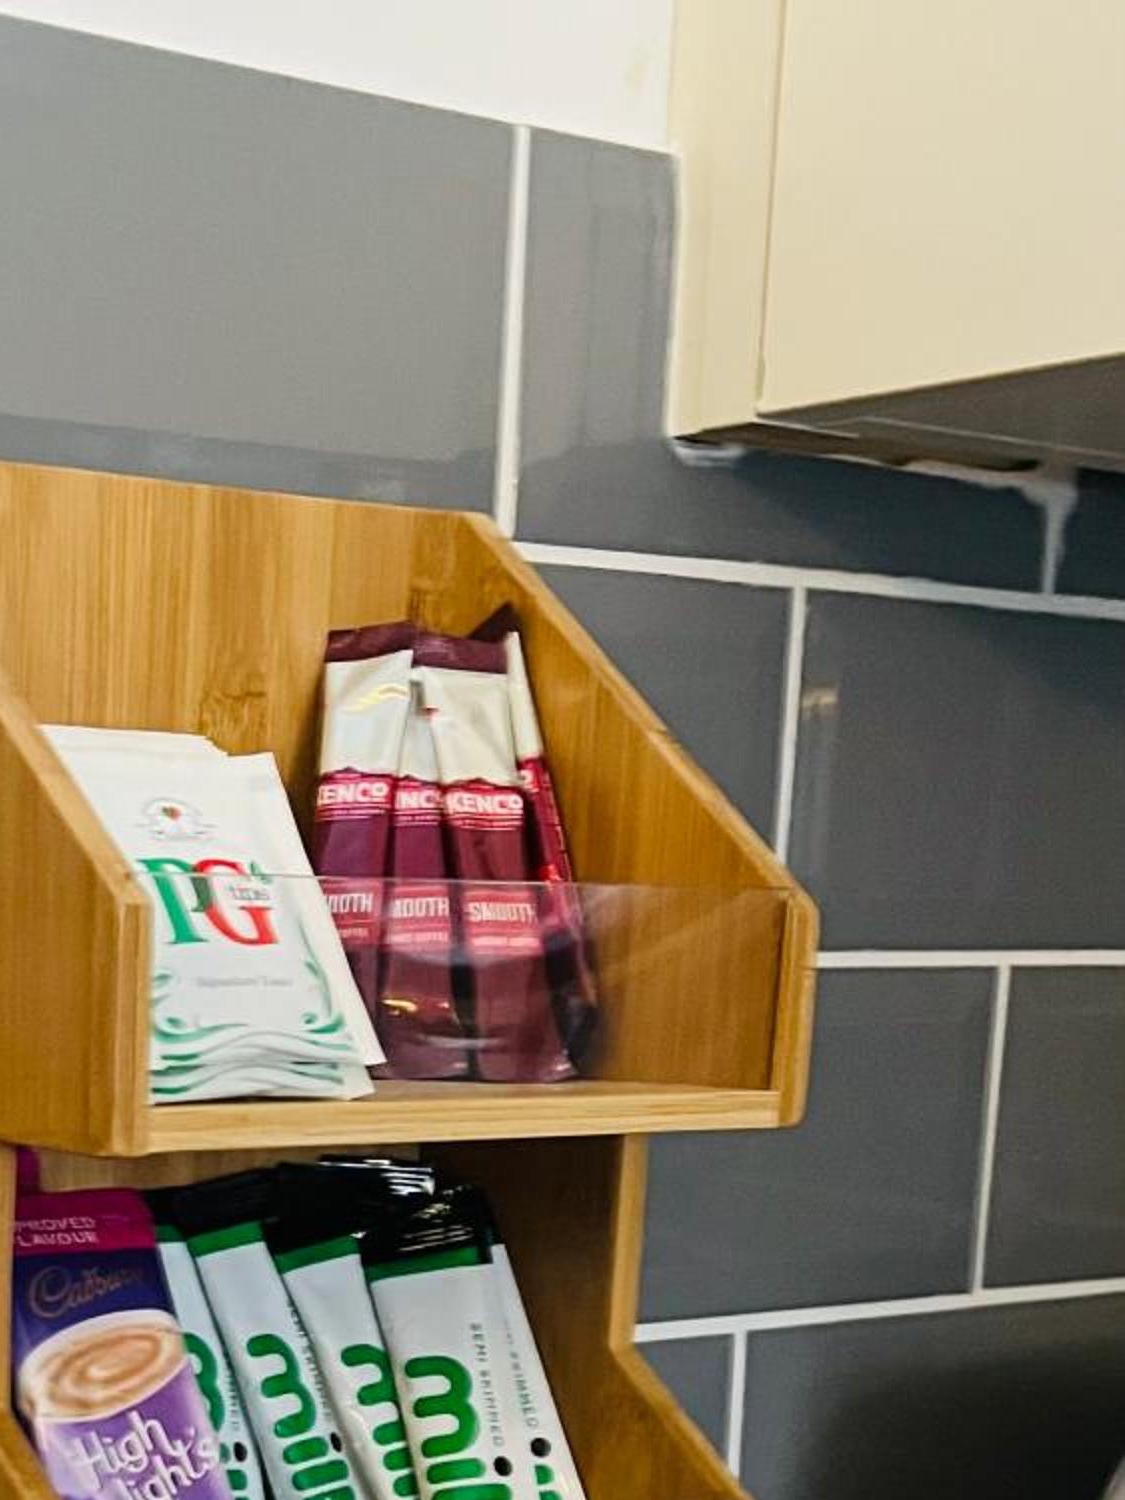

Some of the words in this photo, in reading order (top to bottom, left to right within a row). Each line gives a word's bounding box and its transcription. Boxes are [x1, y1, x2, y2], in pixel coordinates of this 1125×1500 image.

[446, 791, 524, 815] KENCO
[137, 857, 279, 945] PG
[61, 1409, 177, 1491] High
